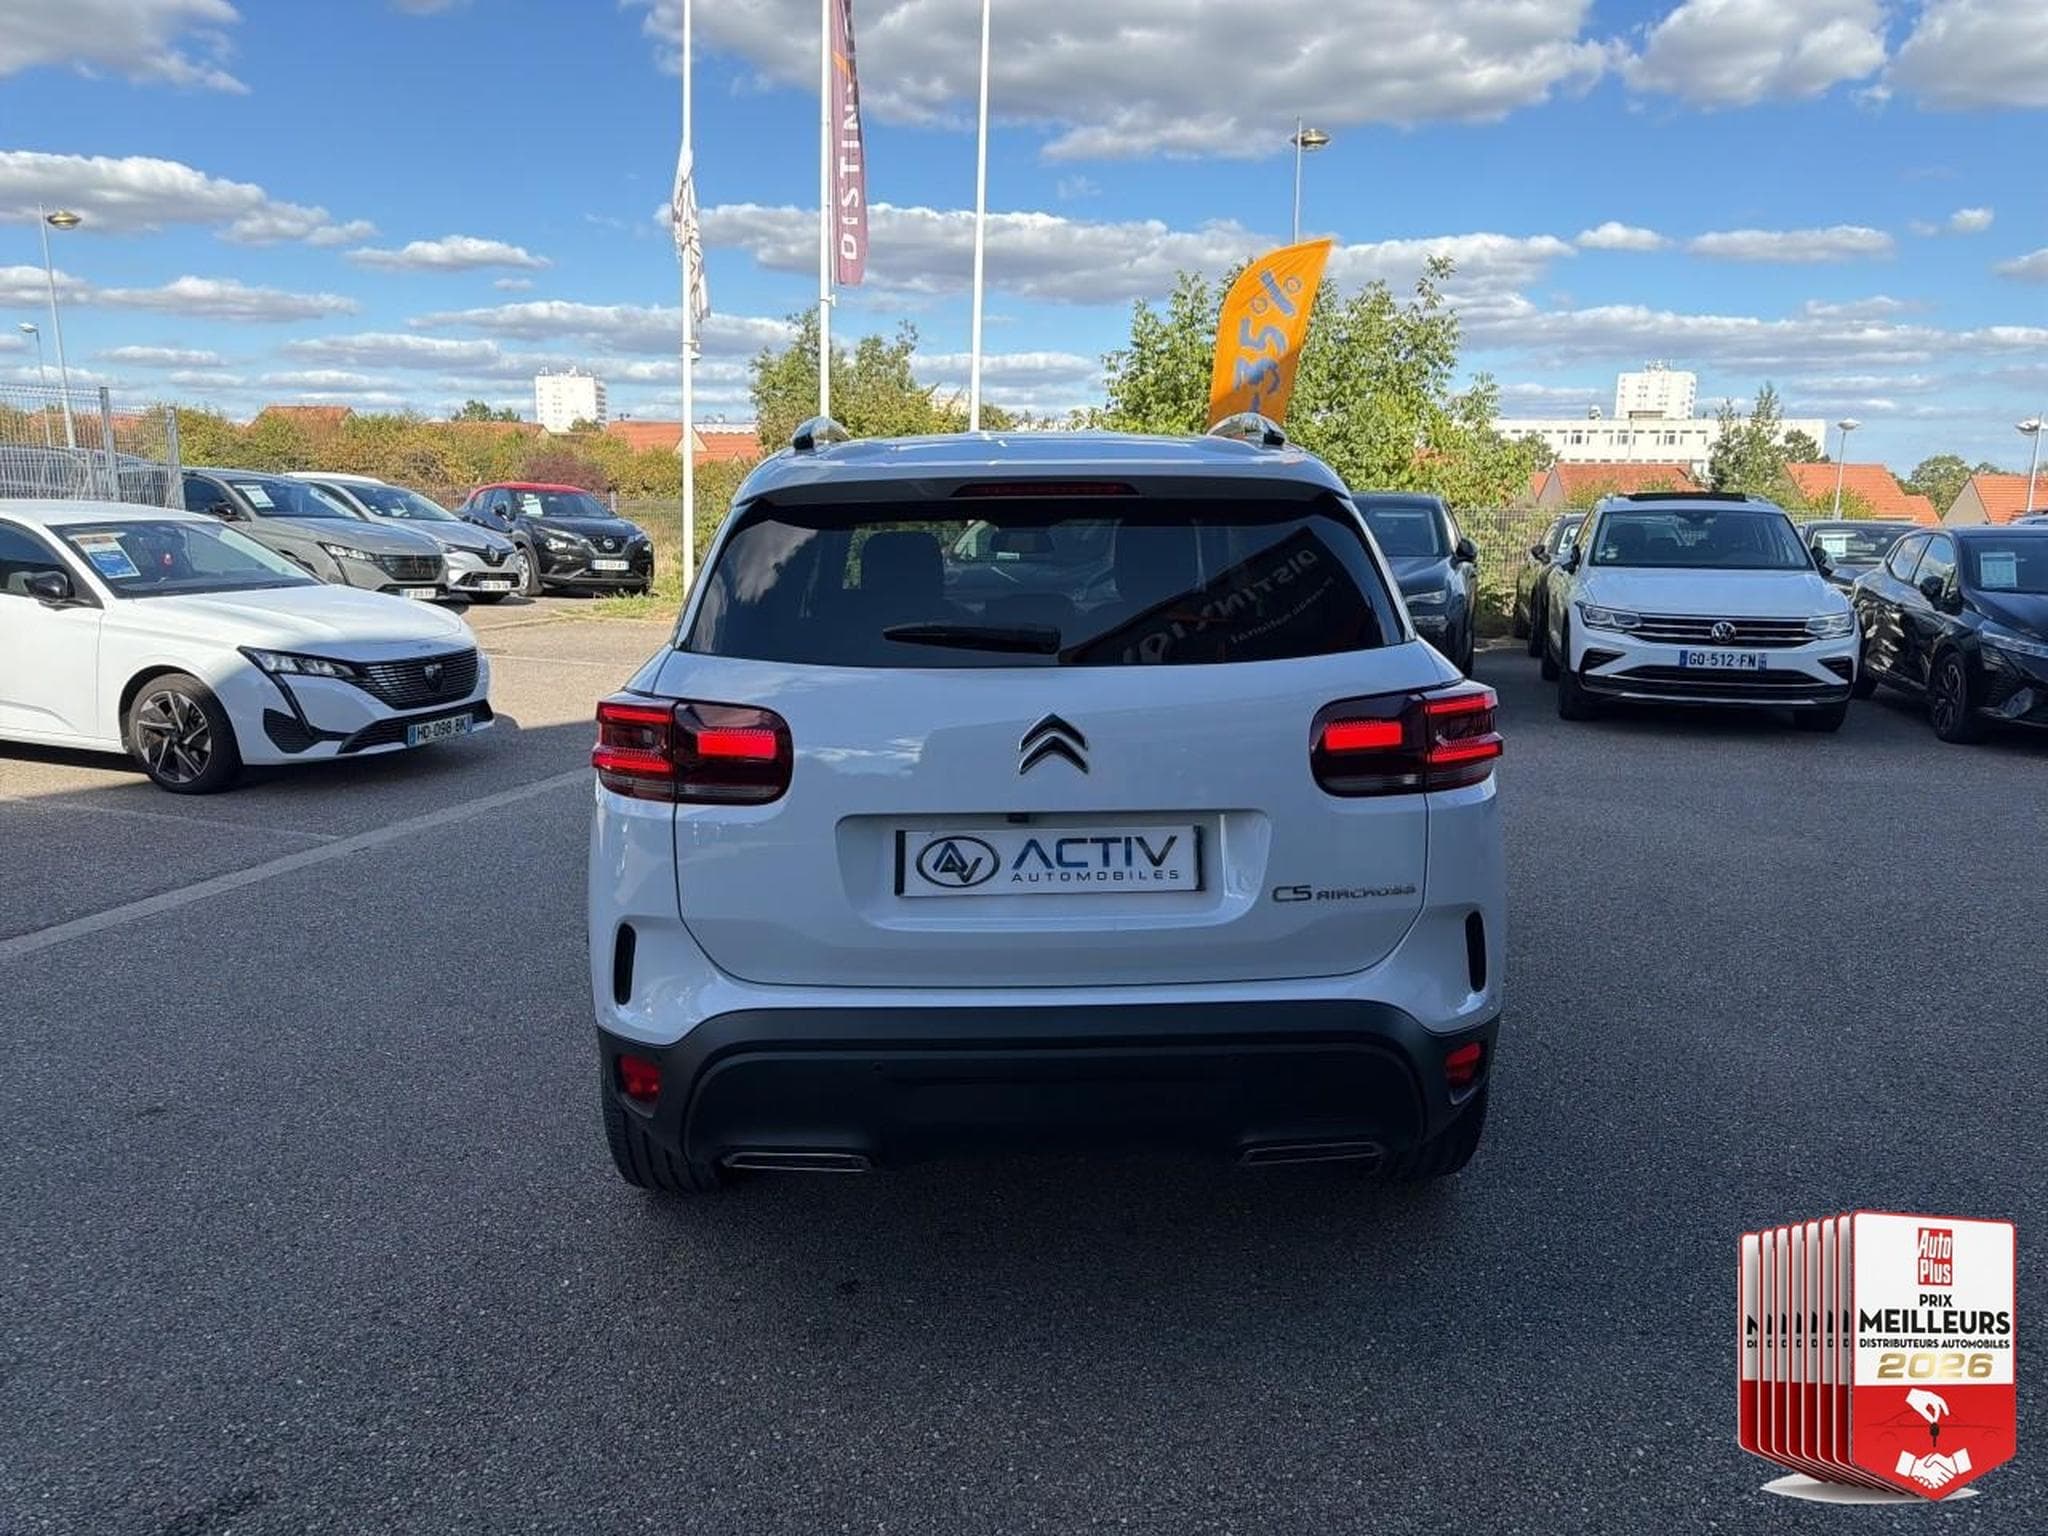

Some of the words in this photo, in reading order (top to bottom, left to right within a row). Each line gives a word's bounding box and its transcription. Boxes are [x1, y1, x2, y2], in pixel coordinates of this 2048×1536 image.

[838, 83, 861, 260] DISTIN
[1012, 835, 1178, 870] ACTIV
[1012, 869, 1180, 883] AUTOMOBILES
[1272, 885, 1312, 903] C5
